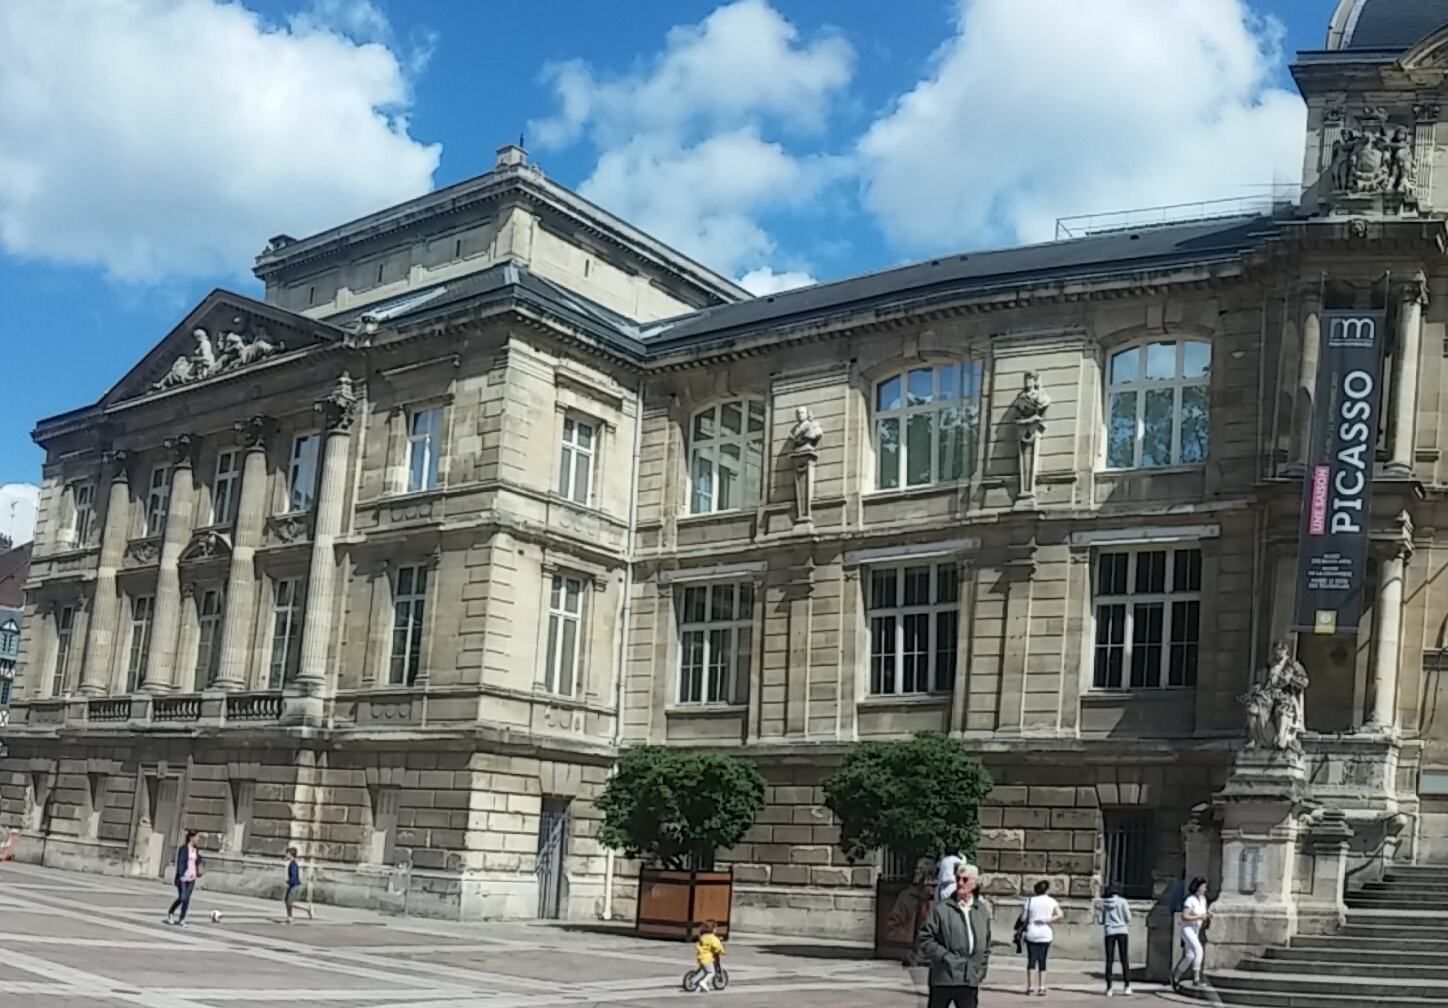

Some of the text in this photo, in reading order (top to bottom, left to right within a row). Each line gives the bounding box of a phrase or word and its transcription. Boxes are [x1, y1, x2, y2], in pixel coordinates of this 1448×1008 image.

[1312, 468, 1328, 532] UNE SAISON
[1330, 371, 1374, 535] PICASSO
